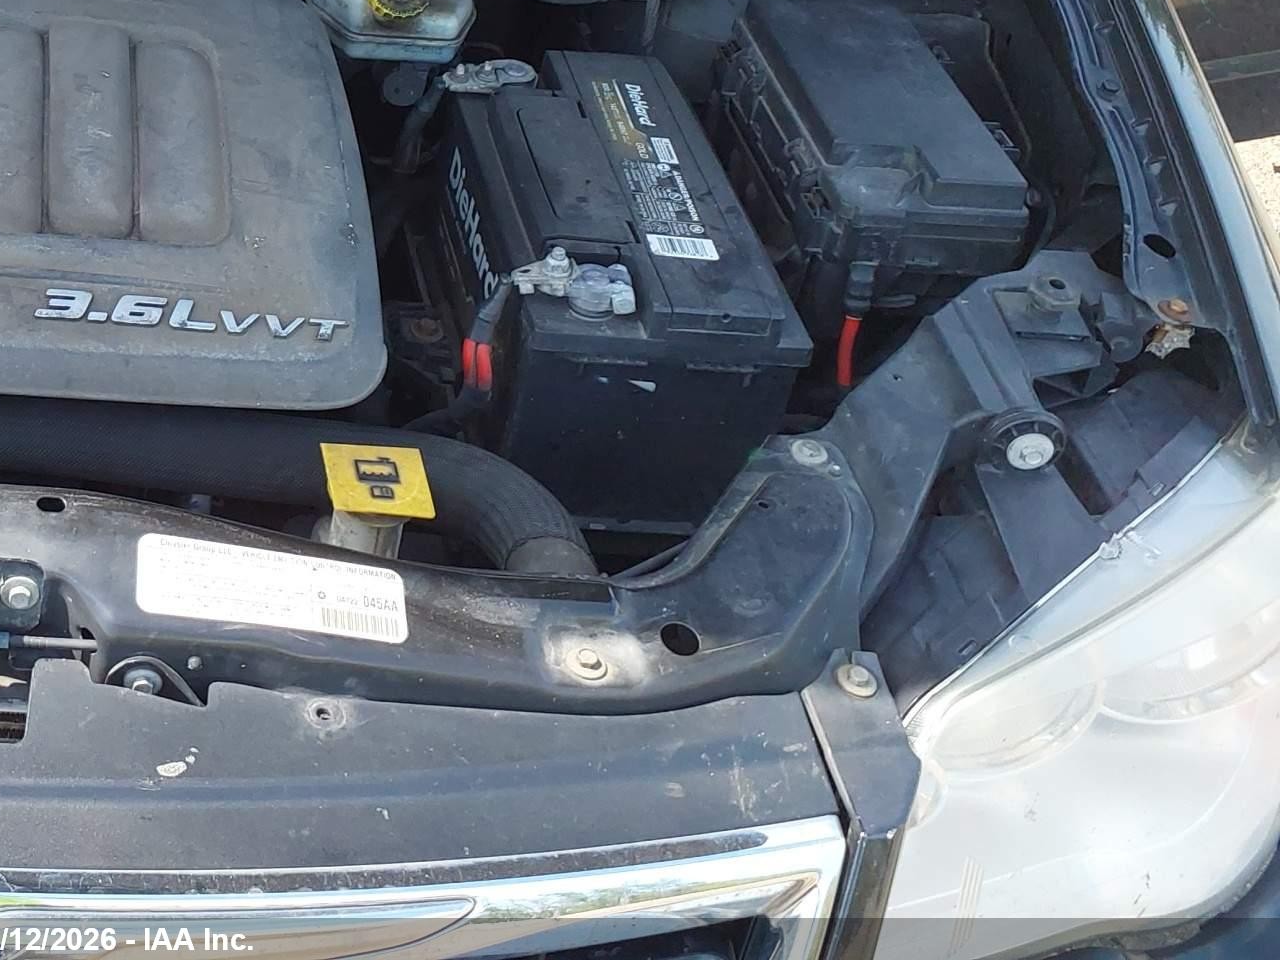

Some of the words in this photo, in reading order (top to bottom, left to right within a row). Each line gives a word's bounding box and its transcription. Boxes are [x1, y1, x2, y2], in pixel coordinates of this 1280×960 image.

[625, 83, 656, 126] DieHard
[635, 143, 648, 158] GOLD
[450, 146, 498, 299] DieHard
[346, 566, 396, 580] INFORMATION
